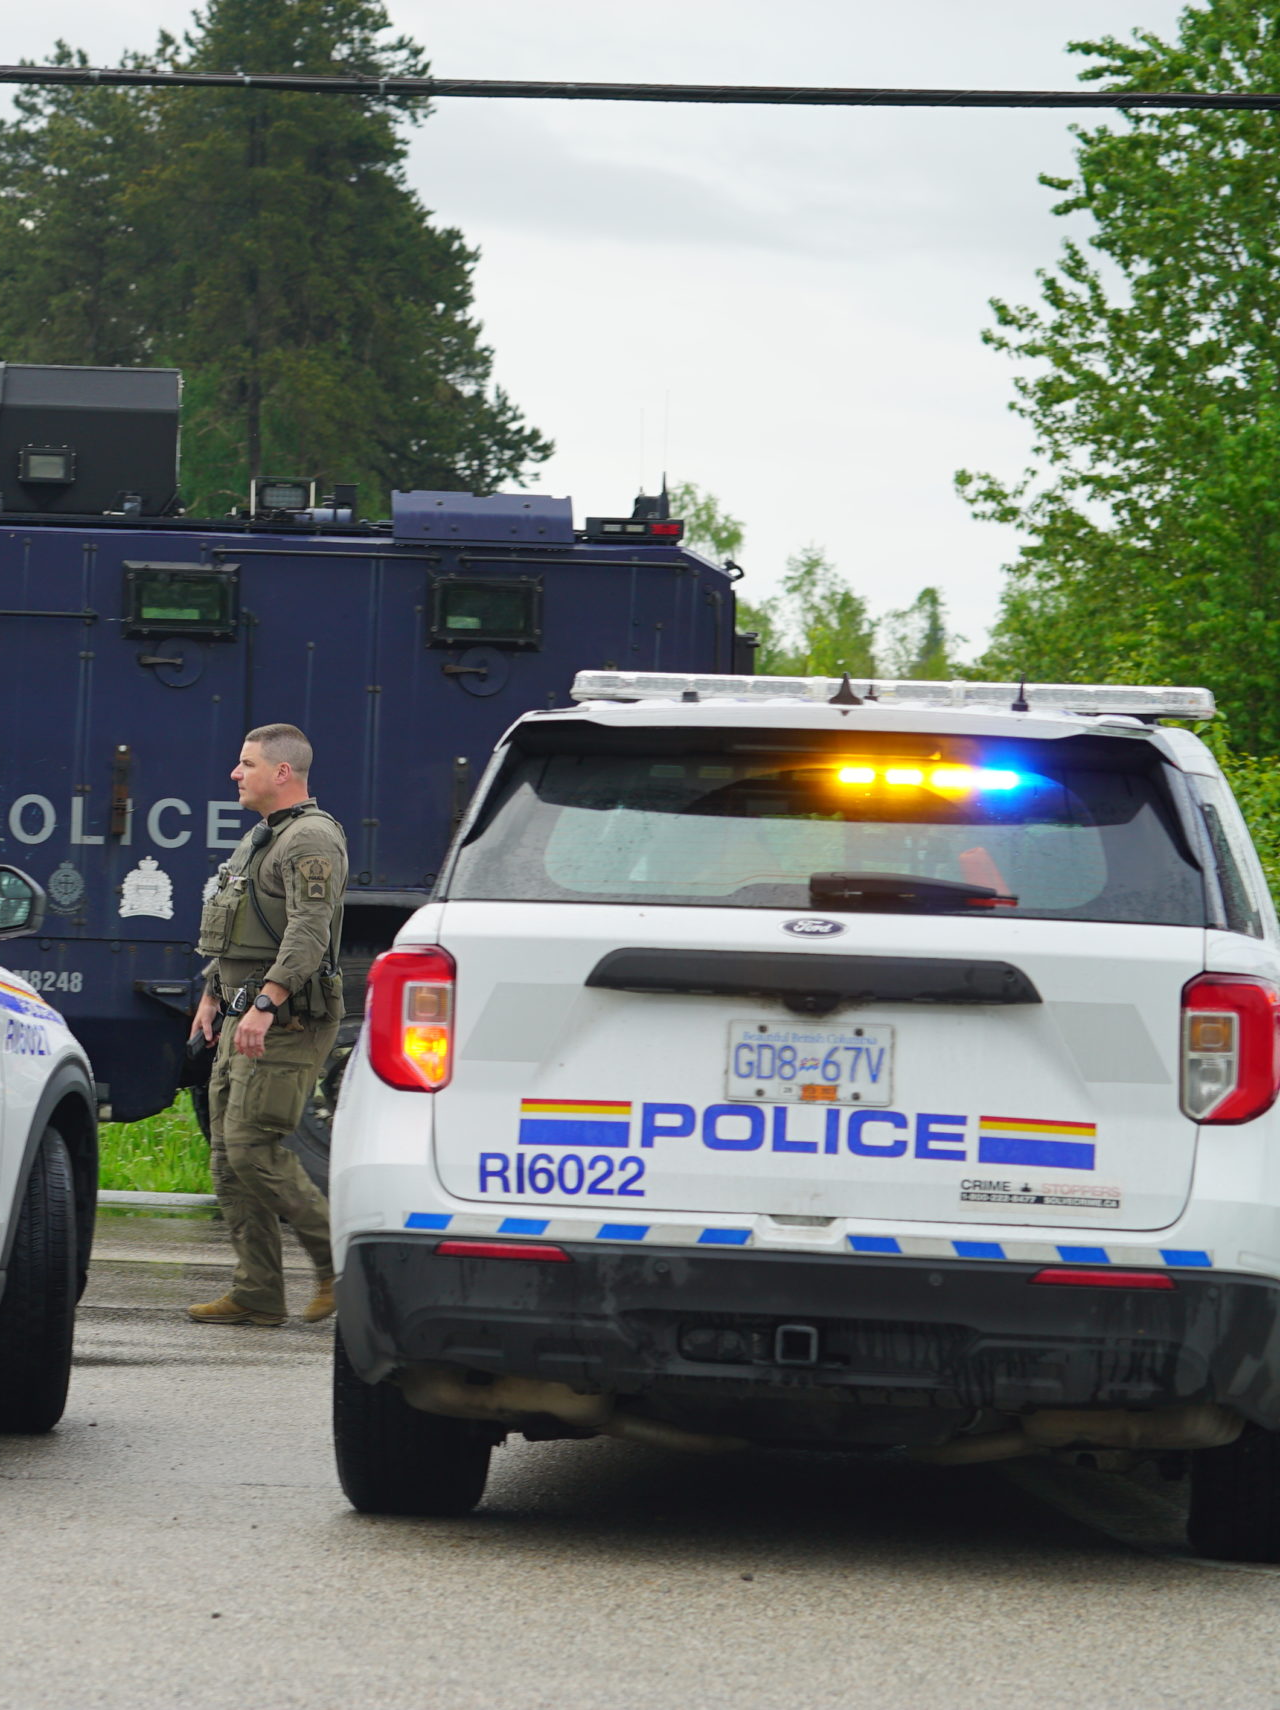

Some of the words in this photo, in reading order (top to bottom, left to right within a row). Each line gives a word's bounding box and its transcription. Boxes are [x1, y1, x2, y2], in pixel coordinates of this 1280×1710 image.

[793, 920, 834, 933] Ford
[743, 1031, 789, 1043] Beautiful
[791, 1033, 825, 1044] British
[827, 1035, 878, 1046] Columbia
[734, 1043, 798, 1081] GD8
[821, 1046, 885, 1084] 67V
[641, 1102, 968, 1162] POLICE
[478, 1152, 646, 1197] RI6022
[960, 1179, 1012, 1192] CRIME
[1040, 1183, 1121, 1198] STOPPERS
